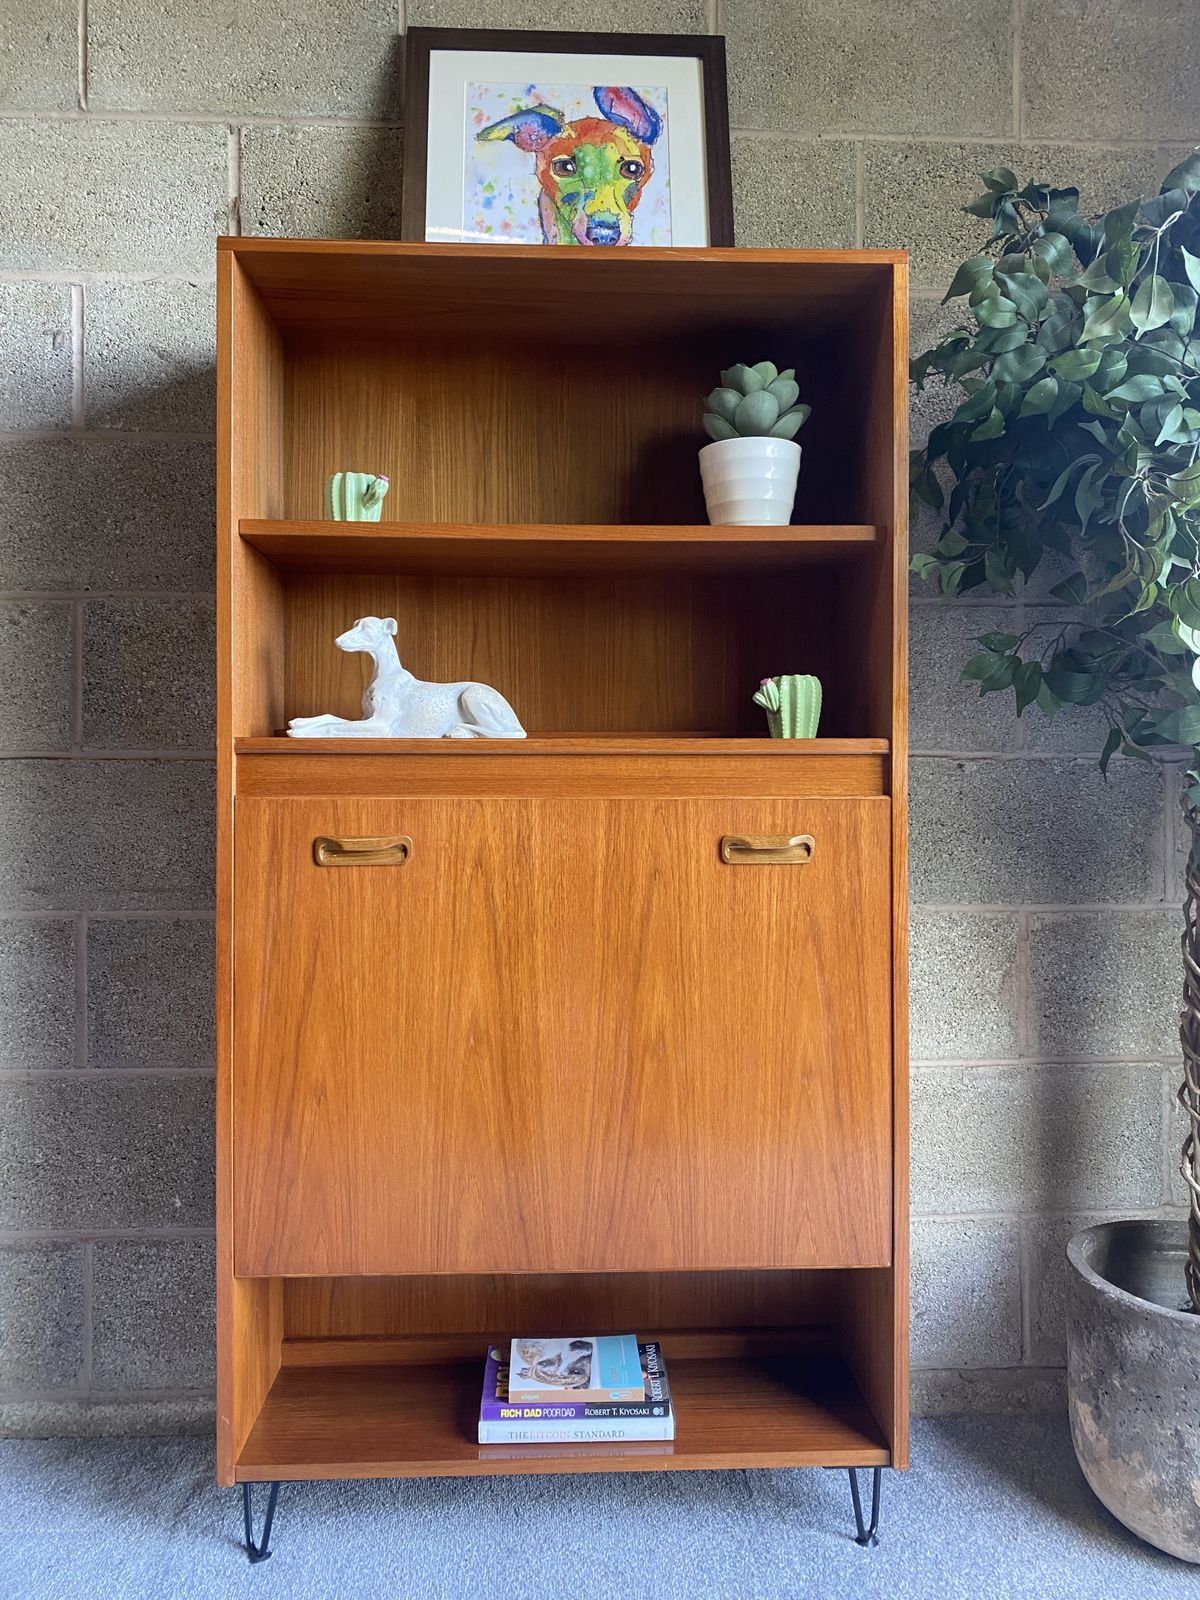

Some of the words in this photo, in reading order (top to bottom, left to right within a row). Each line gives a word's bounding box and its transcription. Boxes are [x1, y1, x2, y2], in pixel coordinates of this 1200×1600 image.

[646, 1344, 659, 1373] KIYOSAKI
[650, 1380, 663, 1402] ROBERT
[500, 1408, 522, 1418] RICH
[523, 1408, 542, 1418] DAD
[542, 1408, 560, 1417] POOR
[561, 1408, 576, 1417] DAD
[584, 1408, 611, 1416] ROBERT
[611, 1407, 618, 1416] T.
[619, 1407, 650, 1416] KIYOSAKI
[508, 1431, 529, 1440] THE
[530, 1430, 571, 1440] BITCOIN
[573, 1430, 625, 1439] STANDARD
